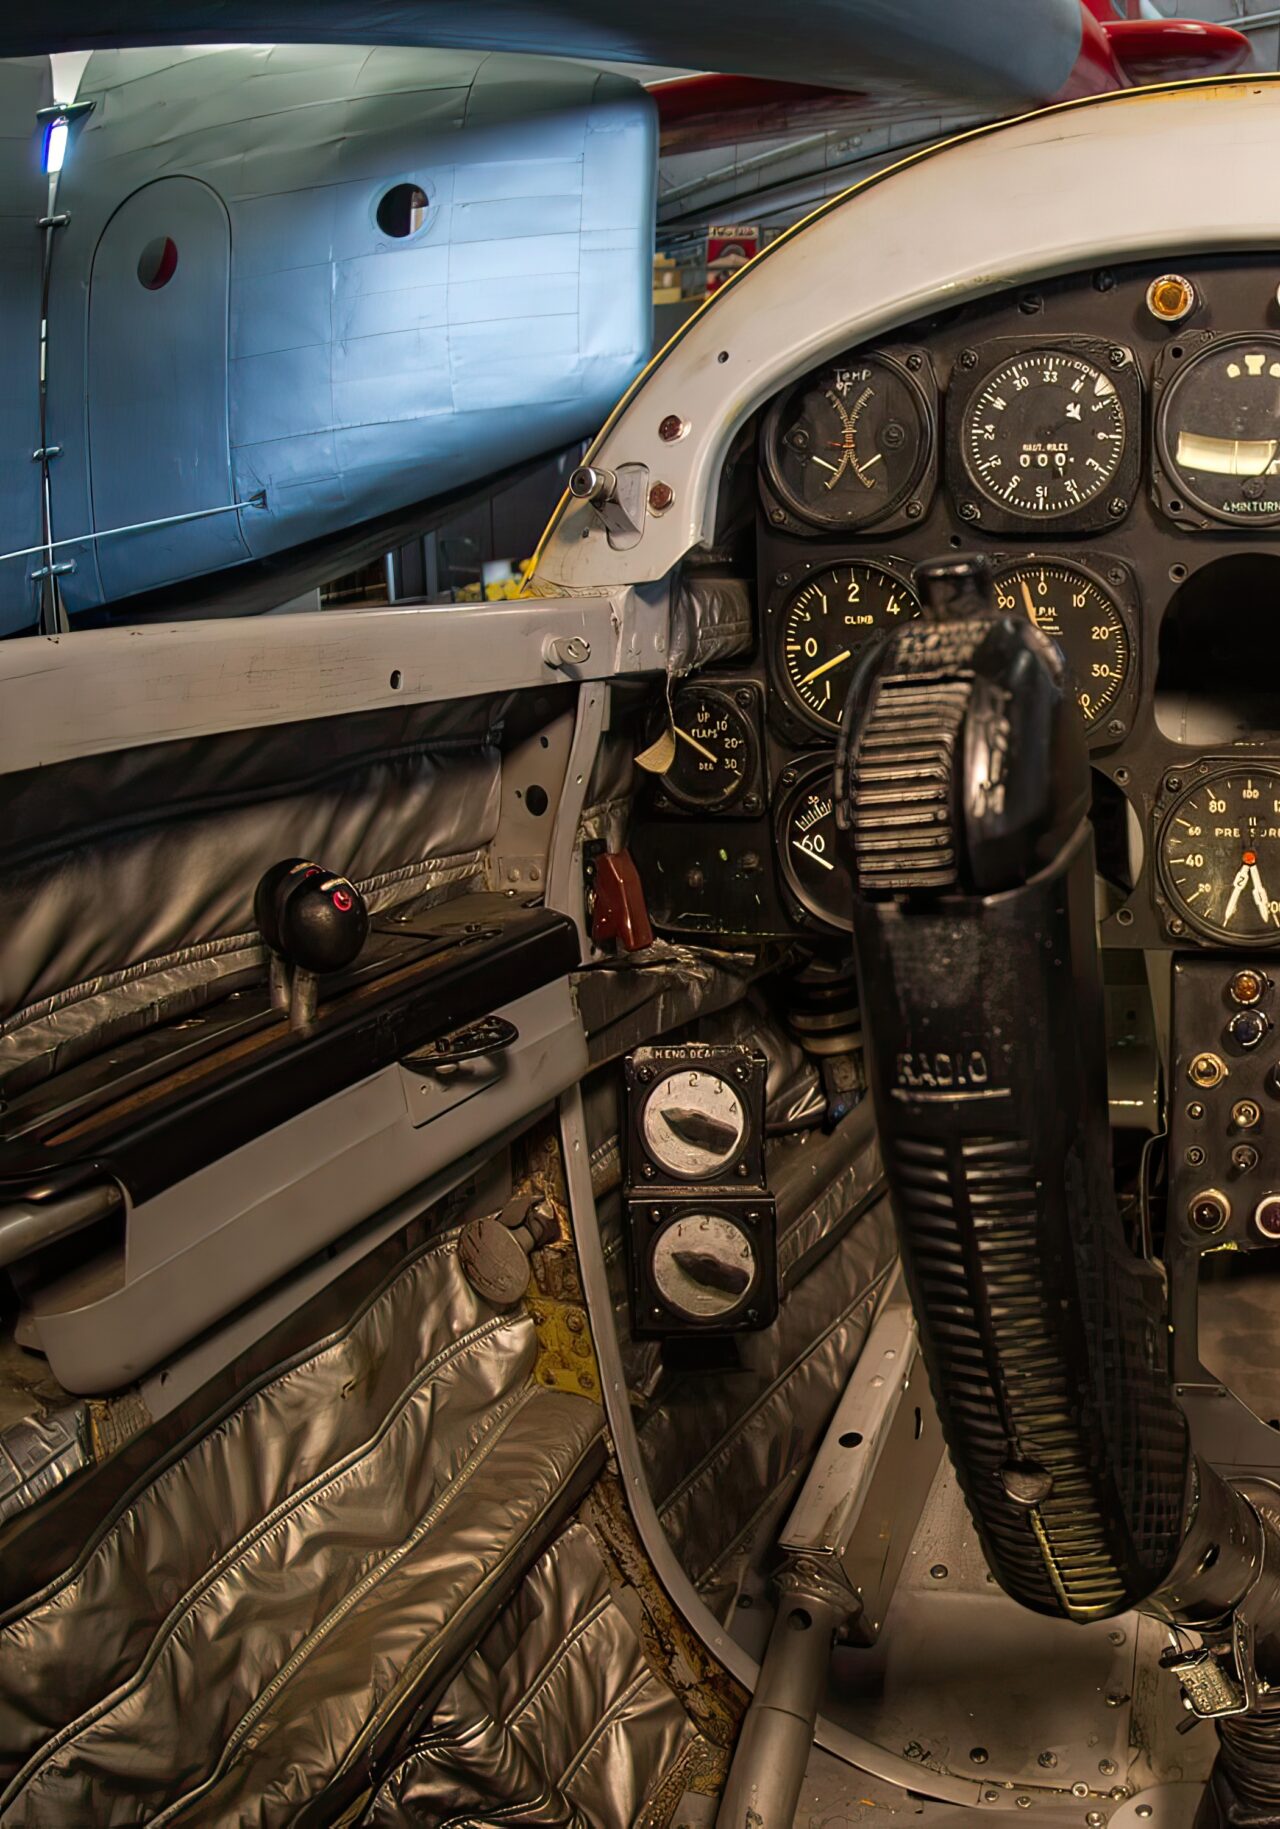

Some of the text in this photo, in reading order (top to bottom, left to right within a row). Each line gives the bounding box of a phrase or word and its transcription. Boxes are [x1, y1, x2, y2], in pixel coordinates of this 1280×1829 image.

[1042, 371, 1058, 382] 33
[1012, 376, 1030, 391] 30
[984, 424, 995, 440] 24
[848, 582, 860, 602] 2
[1038, 582, 1048, 596] 0
[886, 596, 900, 614] 4
[998, 596, 1016, 609] 90
[1072, 594, 1086, 608] 10
[1091, 626, 1109, 640] 20
[804, 637, 818, 658] 0
[697, 712, 710, 722] UP
[716, 721, 728, 731] 10
[724, 738, 738, 748] 20
[724, 758, 737, 769] 30
[1242, 788, 1259, 799] 100
[1208, 800, 1226, 814] 80
[1188, 827, 1202, 836] 60
[1186, 854, 1204, 868] 40
[1198, 884, 1211, 893] 20
[689, 1073, 698, 1087] 2
[714, 1081, 723, 1094] 3
[729, 1102, 737, 1112] 4
